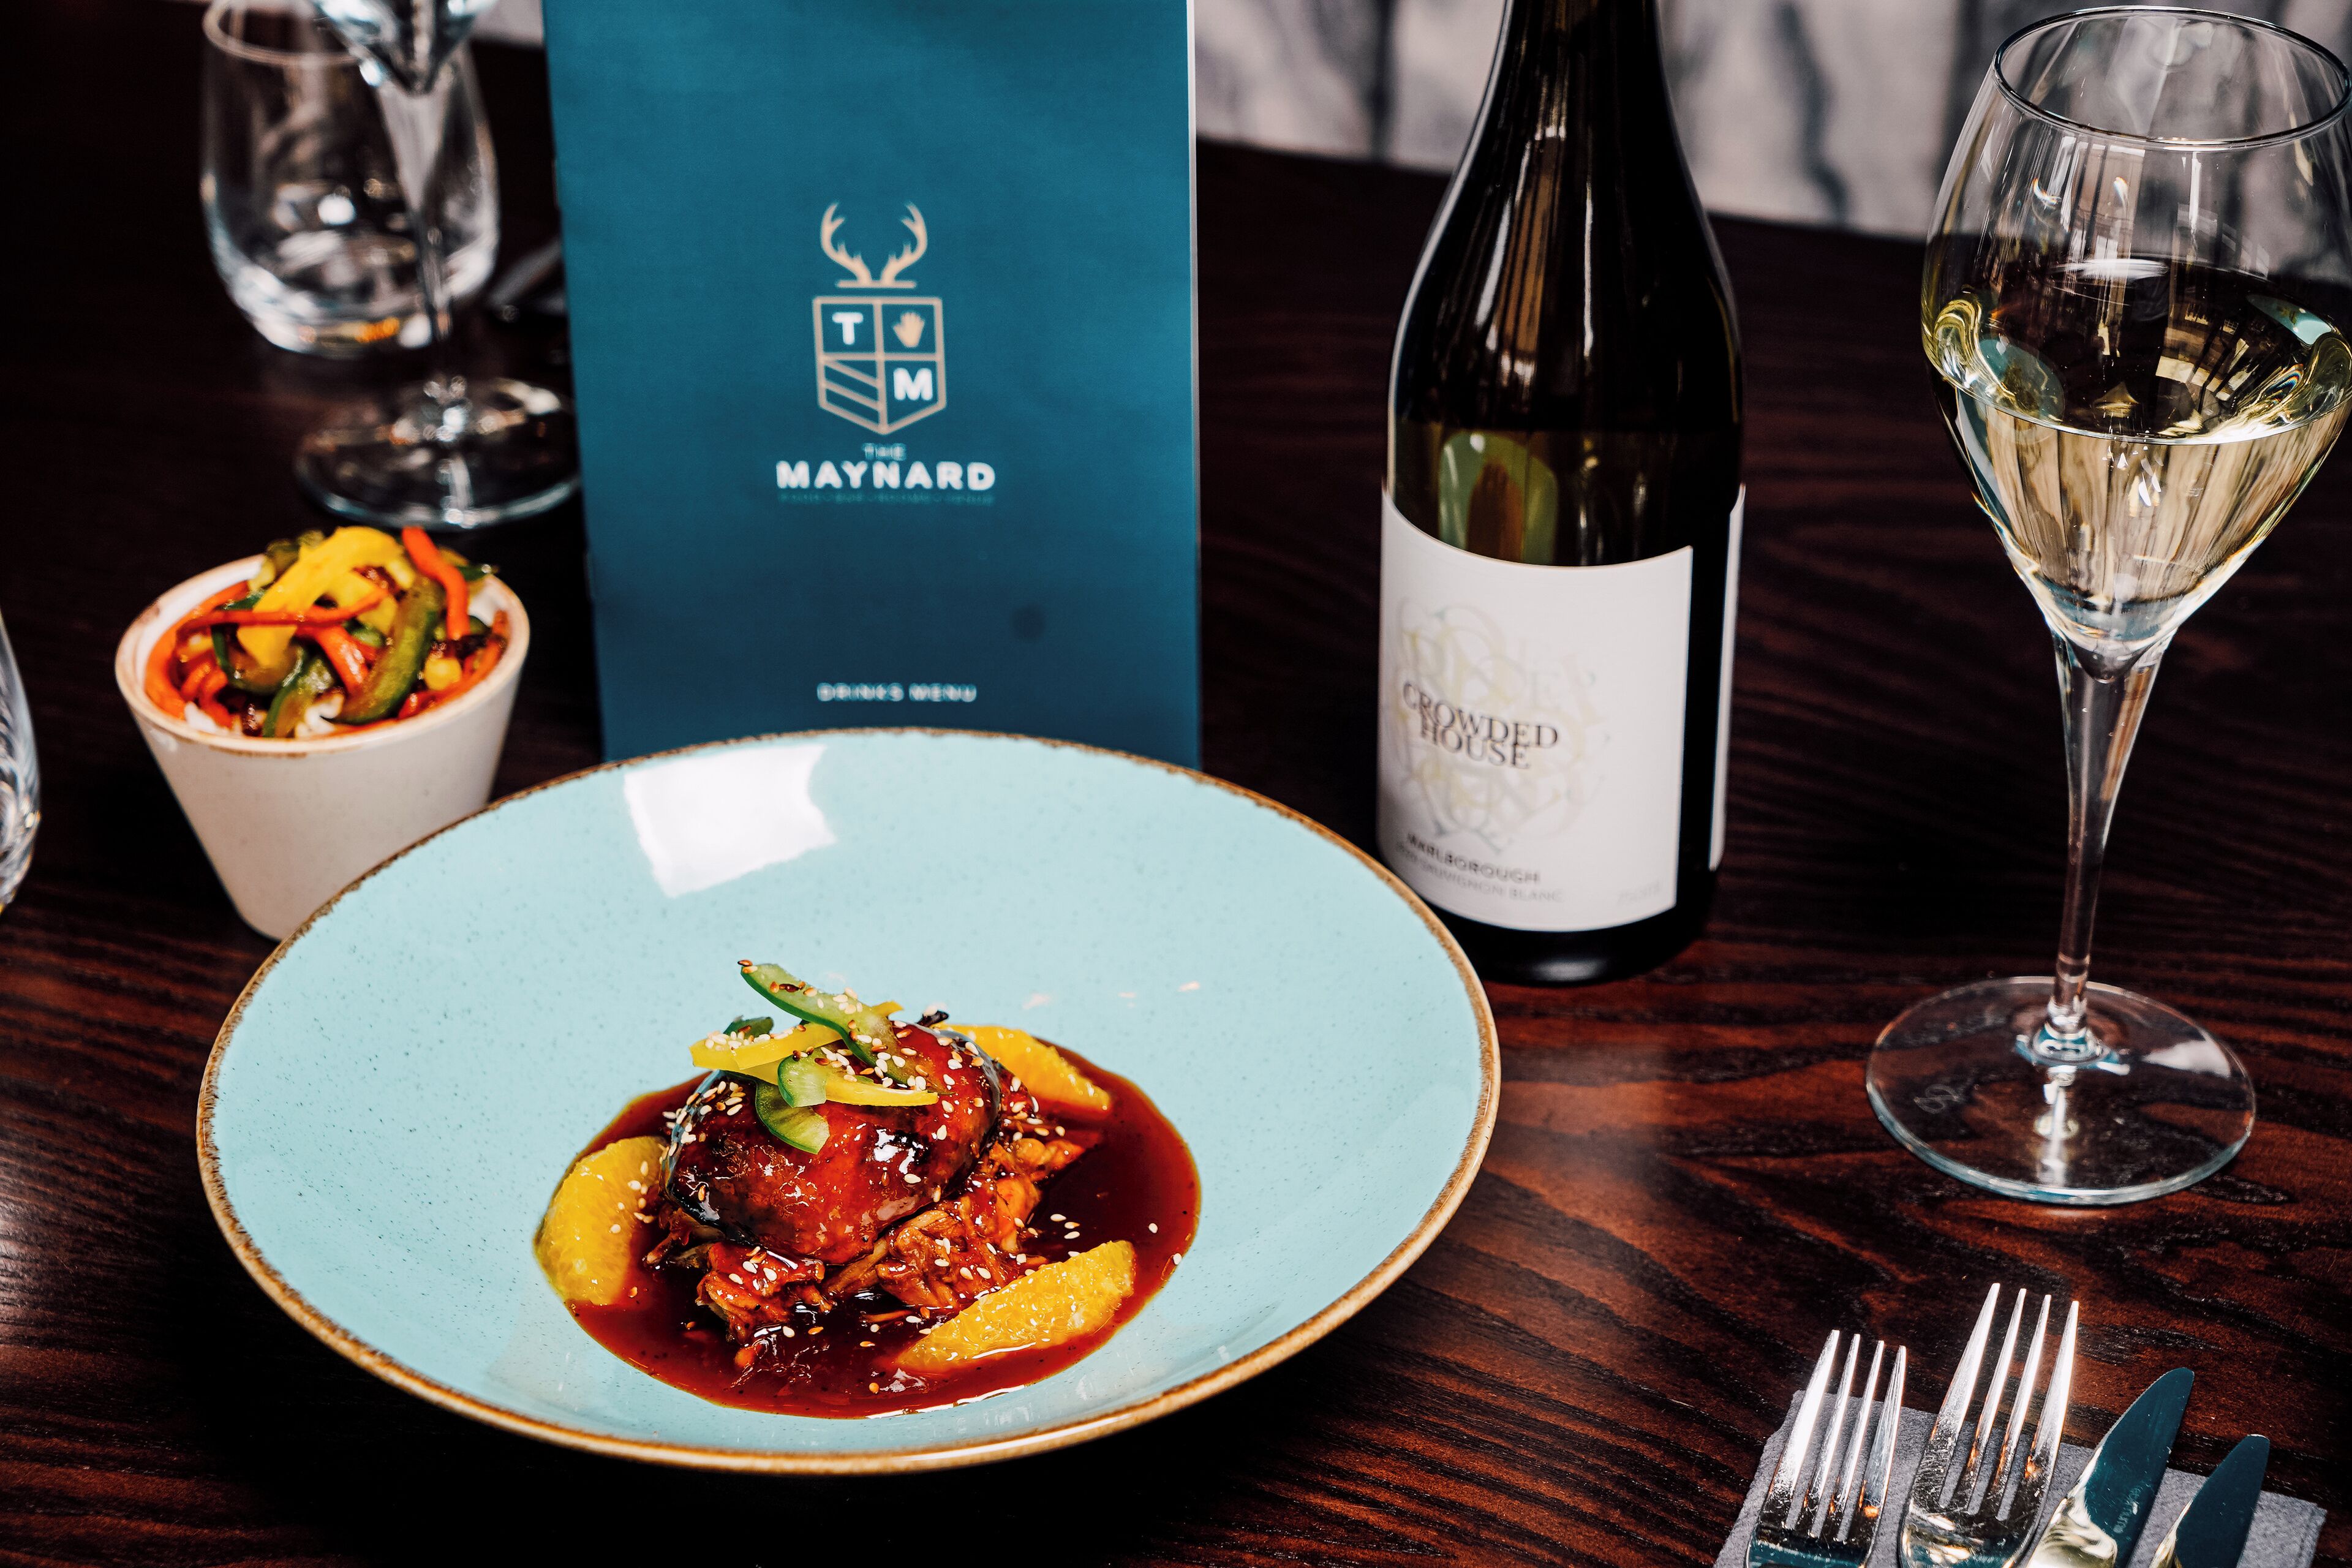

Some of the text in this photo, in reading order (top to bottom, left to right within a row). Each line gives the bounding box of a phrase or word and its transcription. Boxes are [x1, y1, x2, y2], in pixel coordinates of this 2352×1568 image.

[832, 311, 864, 345] T
[893, 368, 933, 401] M
[862, 442, 907, 461] THE
[776, 460, 995, 491] MAYNARD
[817, 682, 977, 703] DRINKS MENU
[1403, 681, 1558, 749] CROWDED
[1420, 711, 1531, 770] HOUSE
[1407, 832, 1540, 884] MARLBOROUGH
